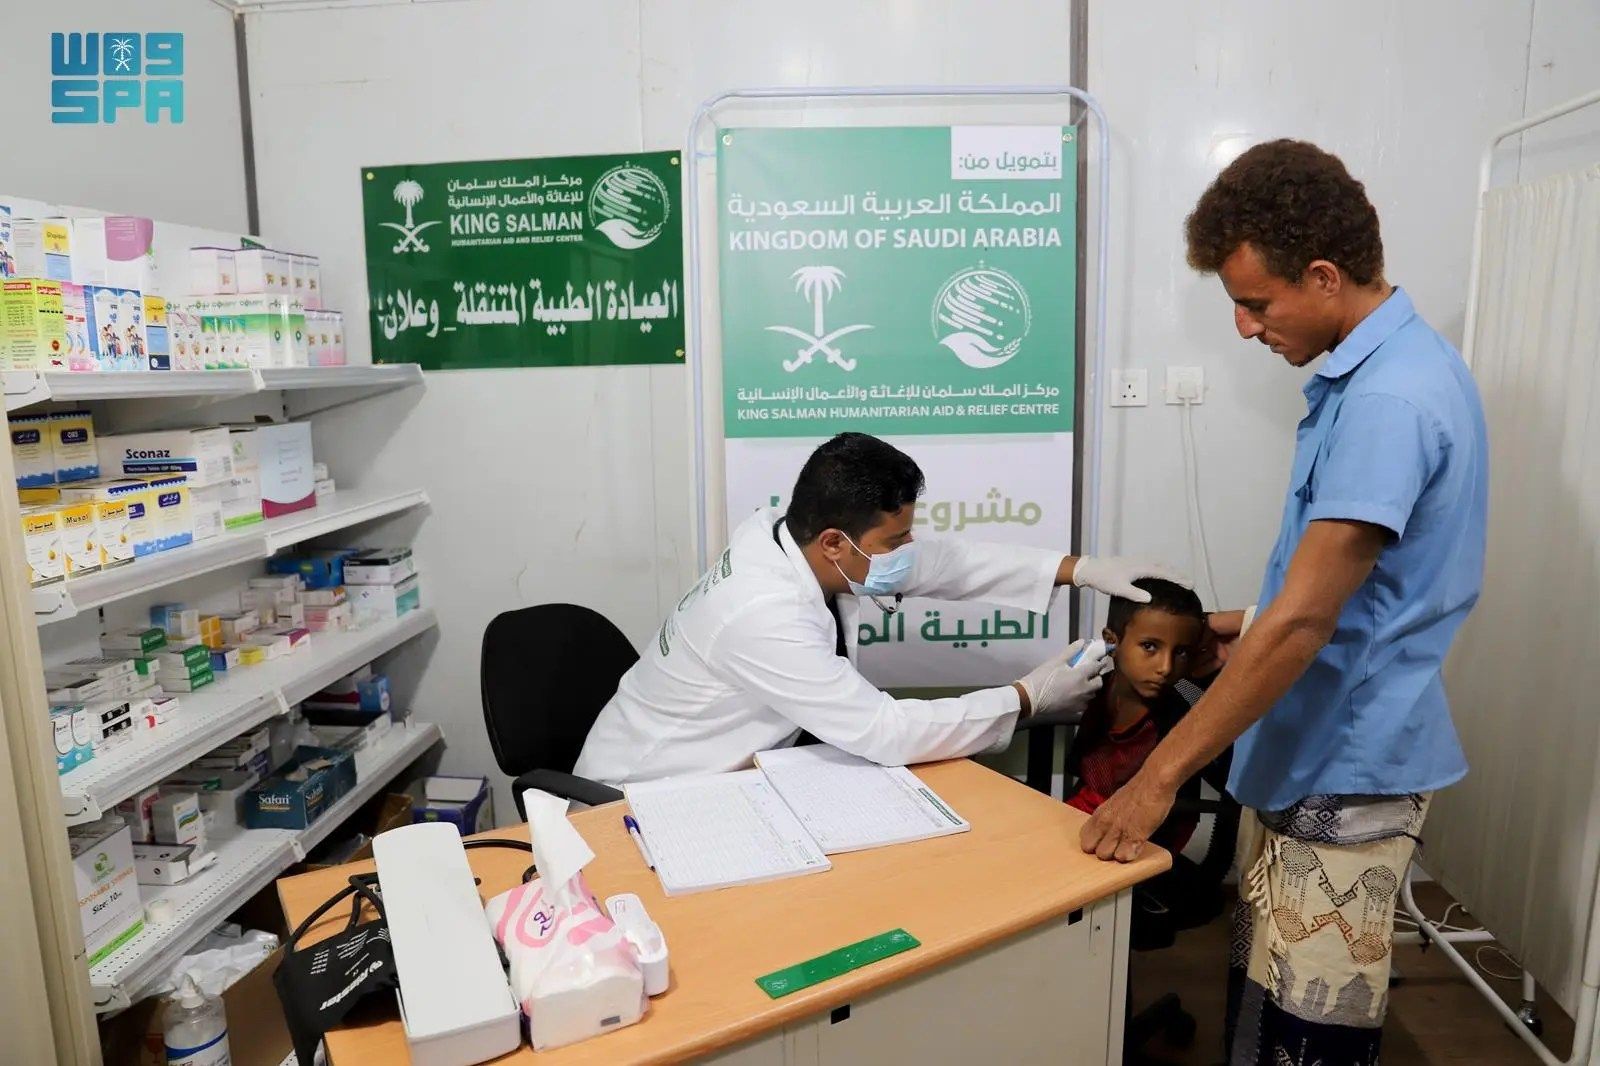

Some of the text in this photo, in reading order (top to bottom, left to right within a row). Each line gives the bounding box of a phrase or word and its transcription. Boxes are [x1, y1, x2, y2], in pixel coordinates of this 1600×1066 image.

[996, 151, 1057, 172] بتمويل
[447, 174, 583, 192] مركز الملك سلمان
[728, 190, 1062, 222] المملكة العربية السعودية
[450, 211, 583, 235] KING SALMAN
[451, 238, 501, 247] HUMANITARIAN
[502, 237, 515, 245] AID
[516, 236, 530, 244] AND
[531, 236, 555, 244] RELIEF
[728, 227, 1062, 251] KINGDOM OF SAUDI ARABIA
[528, 278, 601, 336] الطبية
[606, 279, 677, 333] العيادة
[922, 384, 976, 399] سلمان
[978, 384, 1021, 397] الملك
[1022, 383, 1059, 398] مركز
[737, 403, 1059, 420] KING SALMAN HUMANITARIAN AID & RELIEF CENTRE
[126, 448, 170, 459] Sconaz
[920, 609, 1049, 648] الطبية
